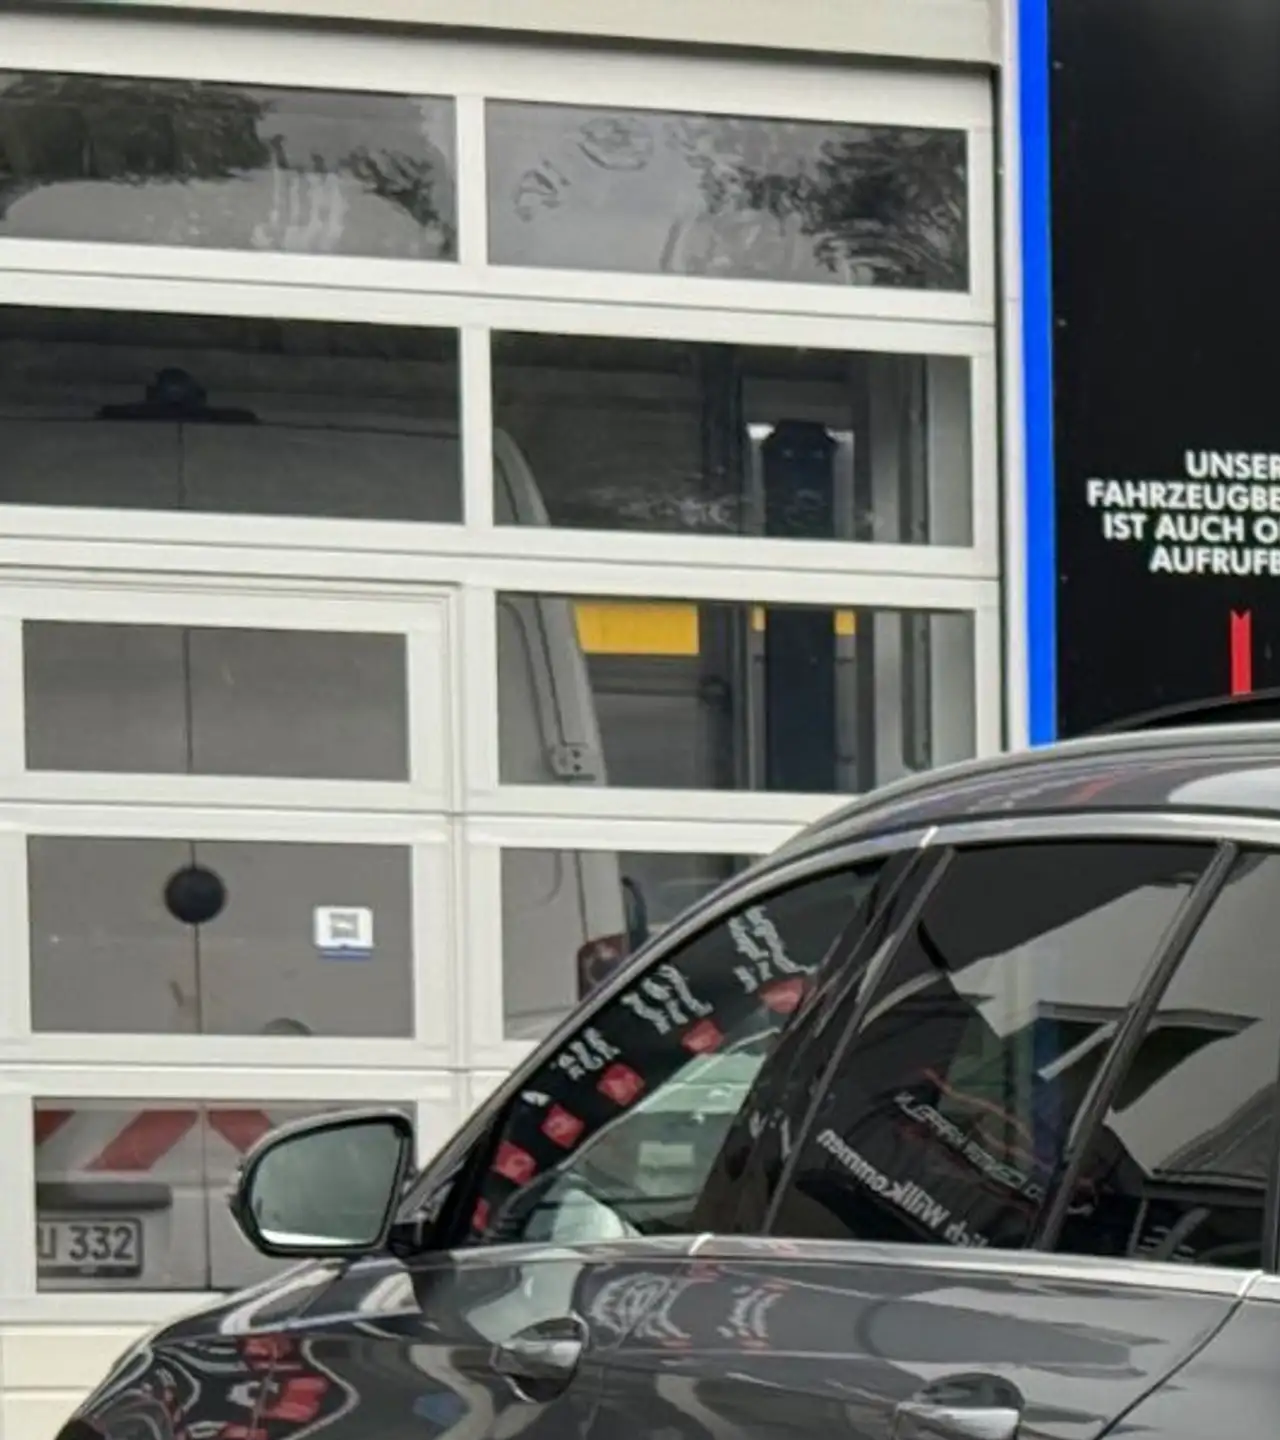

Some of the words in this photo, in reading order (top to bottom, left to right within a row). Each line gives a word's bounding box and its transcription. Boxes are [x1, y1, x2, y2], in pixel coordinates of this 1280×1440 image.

[1102, 513, 1148, 541] IST
[1154, 513, 1246, 543] AUCH
[69, 1226, 133, 1260] 332
